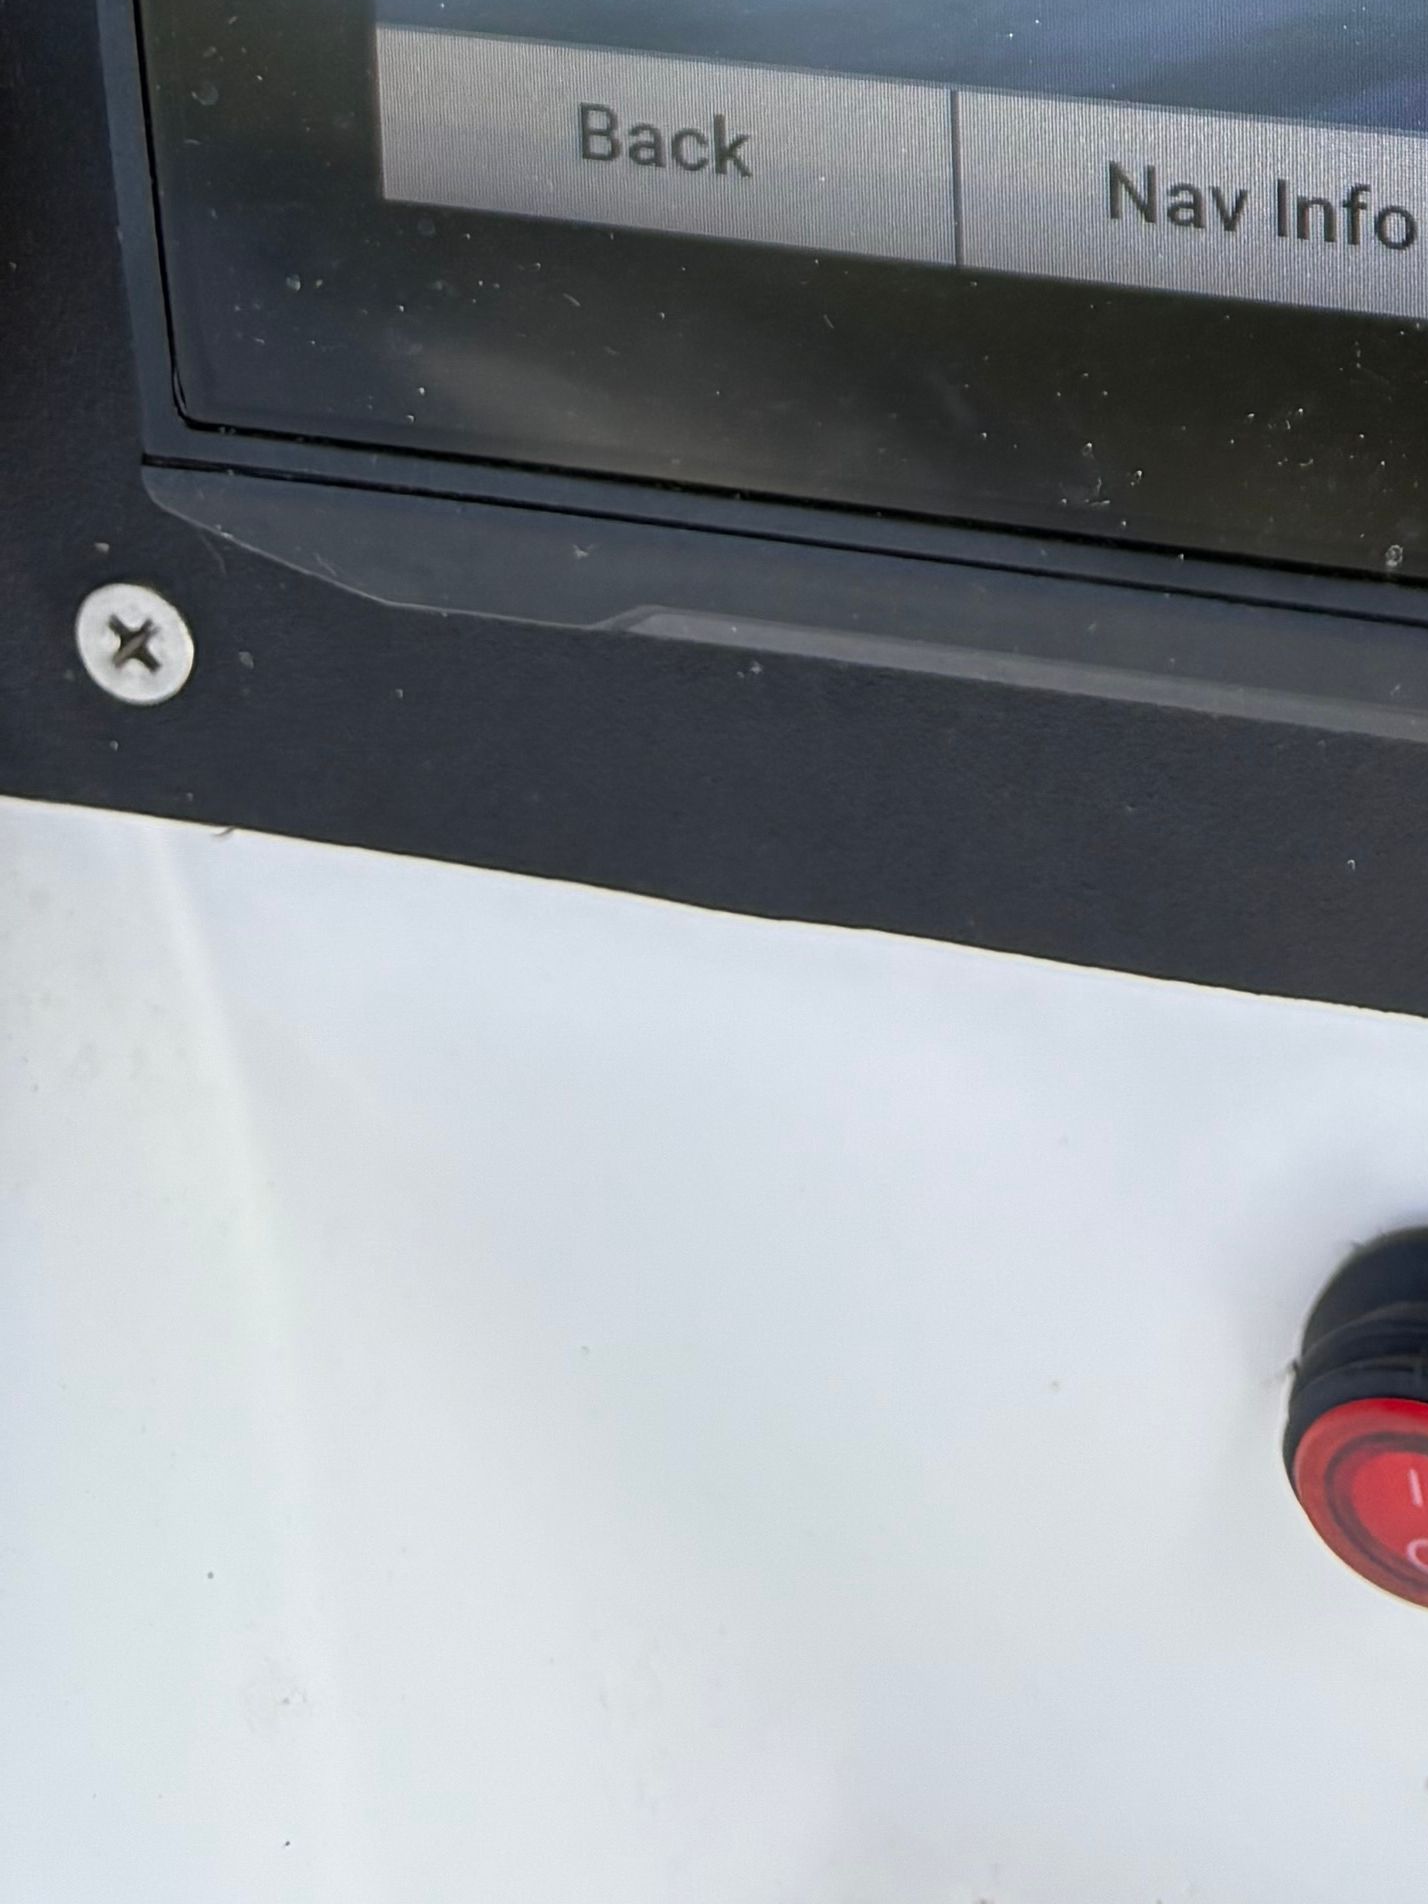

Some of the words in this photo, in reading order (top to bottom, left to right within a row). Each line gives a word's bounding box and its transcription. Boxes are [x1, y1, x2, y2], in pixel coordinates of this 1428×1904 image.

[577, 101, 753, 179] Back
[1106, 159, 1248, 237] Nav
[1273, 178, 1419, 252] Info
